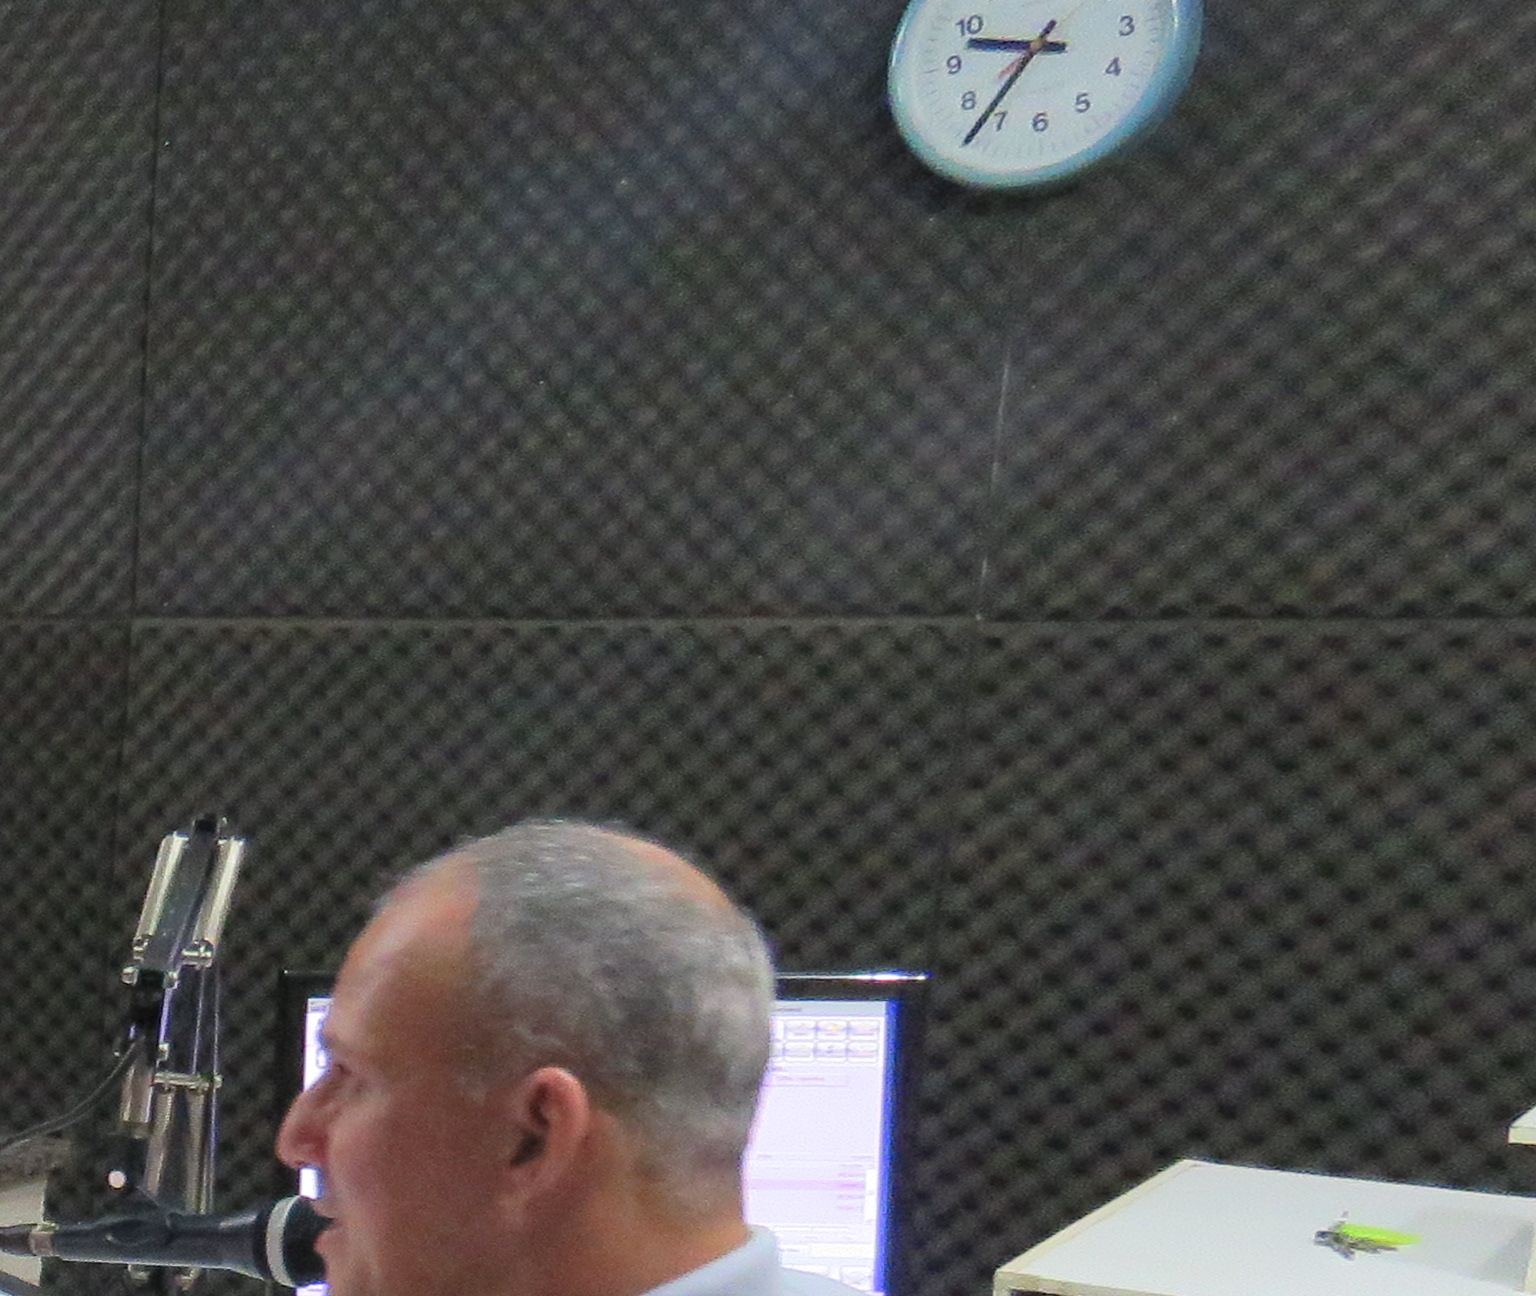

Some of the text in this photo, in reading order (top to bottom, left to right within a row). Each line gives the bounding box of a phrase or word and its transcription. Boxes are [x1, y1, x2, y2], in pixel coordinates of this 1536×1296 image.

[955, 14, 984, 36] 10
[1118, 15, 1136, 36] 3
[946, 54, 963, 75] 9
[1105, 57, 1122, 77] 4
[960, 91, 977, 111] 8
[1075, 92, 1092, 114] 5
[993, 111, 1009, 132] 7
[1031, 112, 1049, 132] 6
